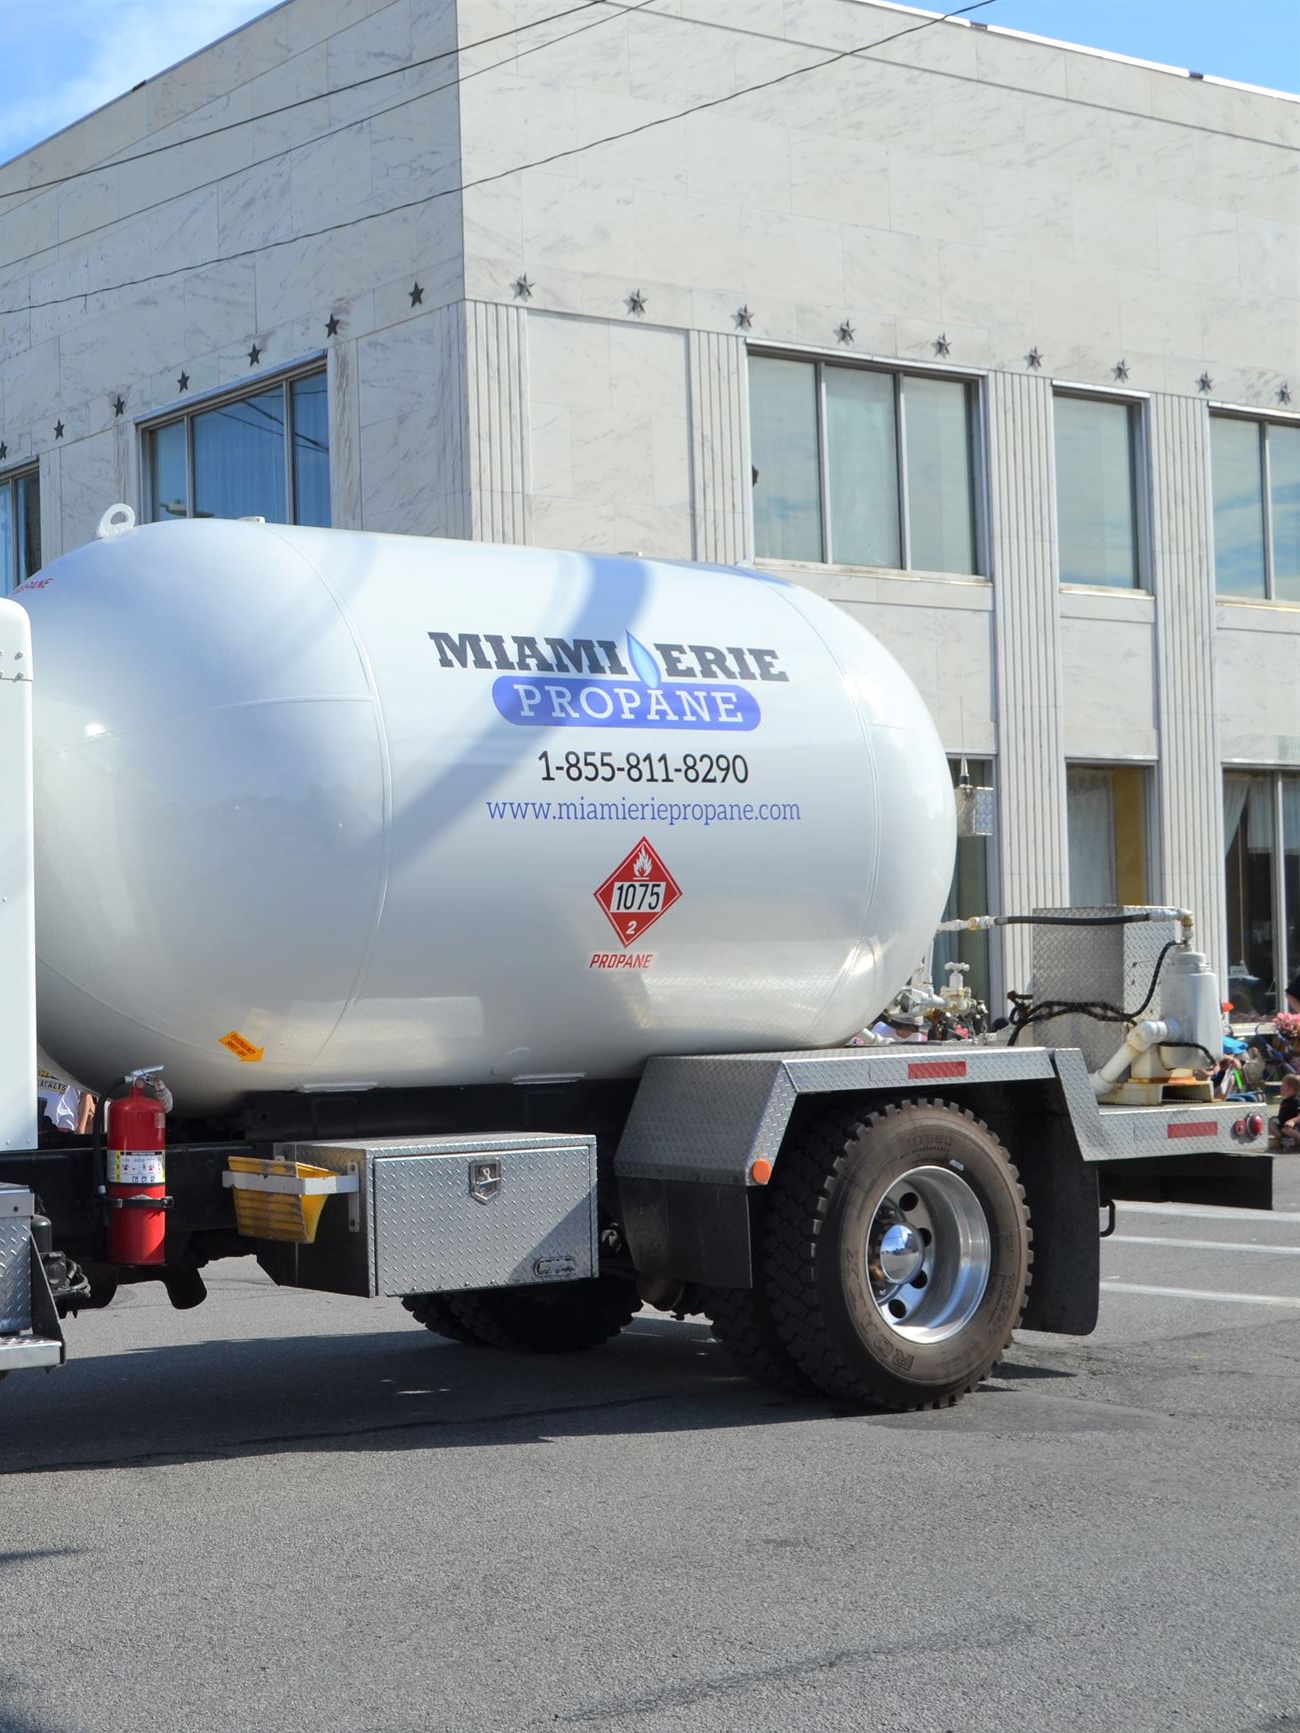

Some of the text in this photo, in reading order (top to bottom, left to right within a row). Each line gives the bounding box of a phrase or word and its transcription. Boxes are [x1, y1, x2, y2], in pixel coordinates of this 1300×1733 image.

[427, 632, 790, 682] MIAMI ERIE
[513, 684, 744, 723] PROPANE
[538, 751, 749, 784] 1-855-811-8290
[486, 797, 801, 826] www.miamieriepropane.com
[616, 883, 661, 911] 1075
[625, 920, 637, 935] 2
[589, 953, 653, 969] PROPANE
